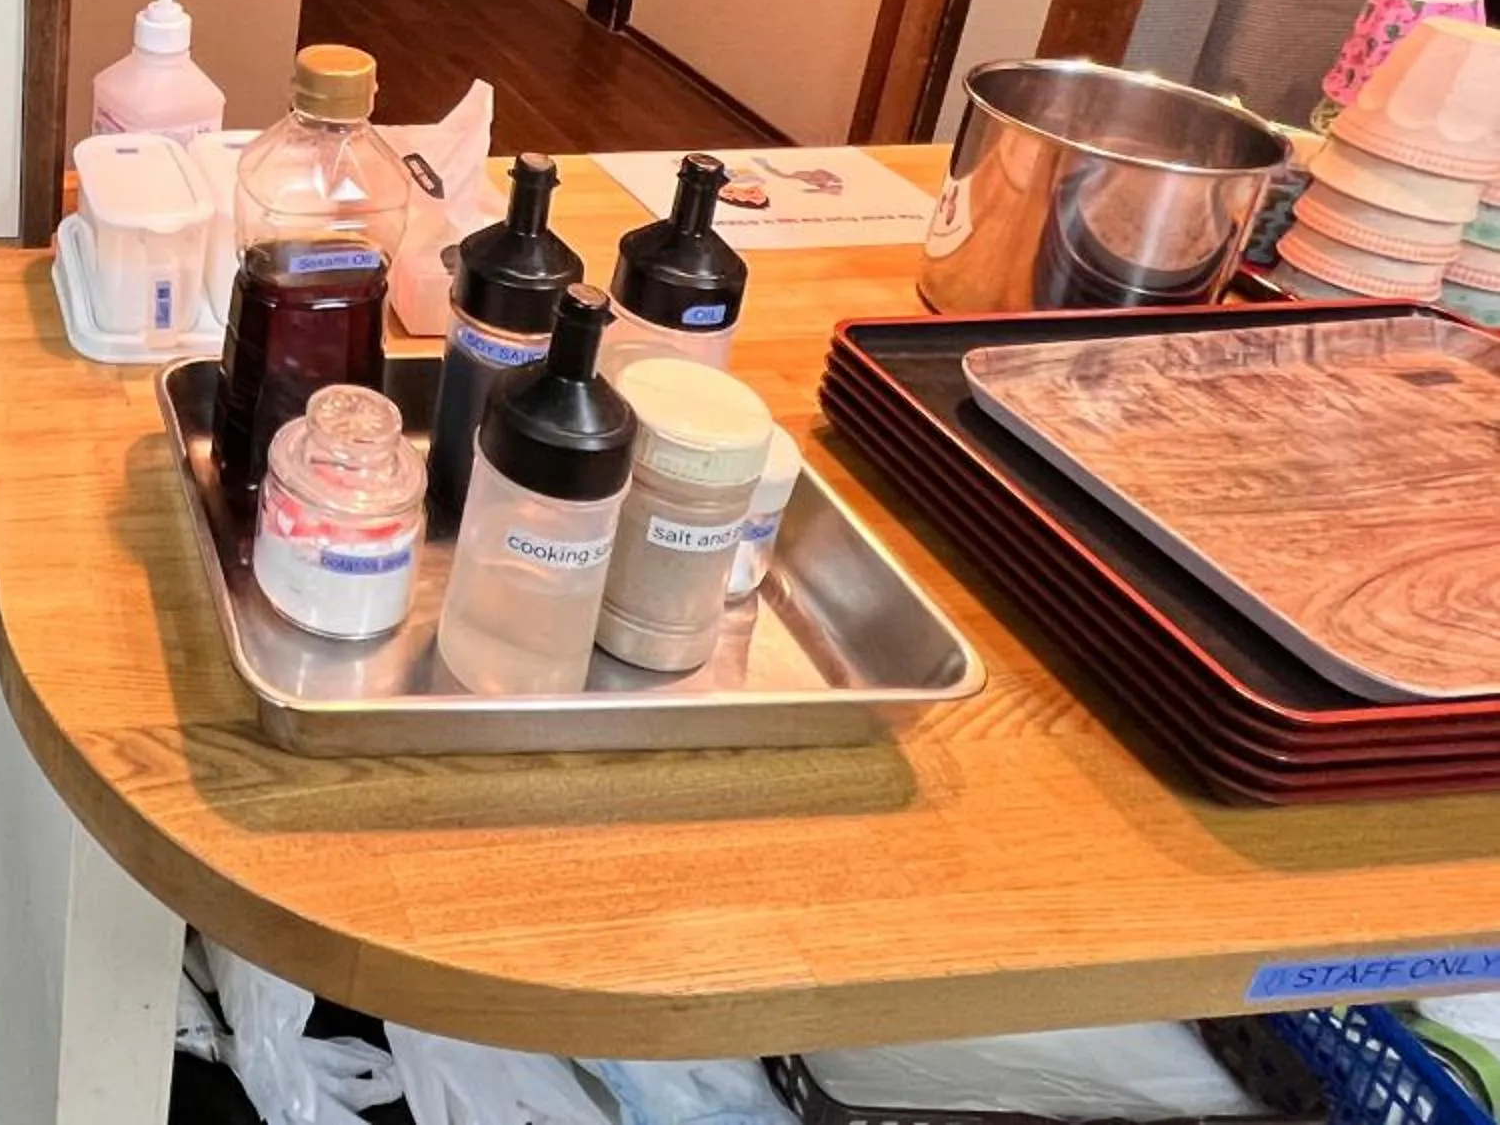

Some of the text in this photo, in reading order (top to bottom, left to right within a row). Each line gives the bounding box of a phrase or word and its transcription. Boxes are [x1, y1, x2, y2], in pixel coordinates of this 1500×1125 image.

[508, 536, 589, 566] cooking
[652, 526, 692, 546] salt
[1293, 954, 1500, 988] STAFF ONLY
